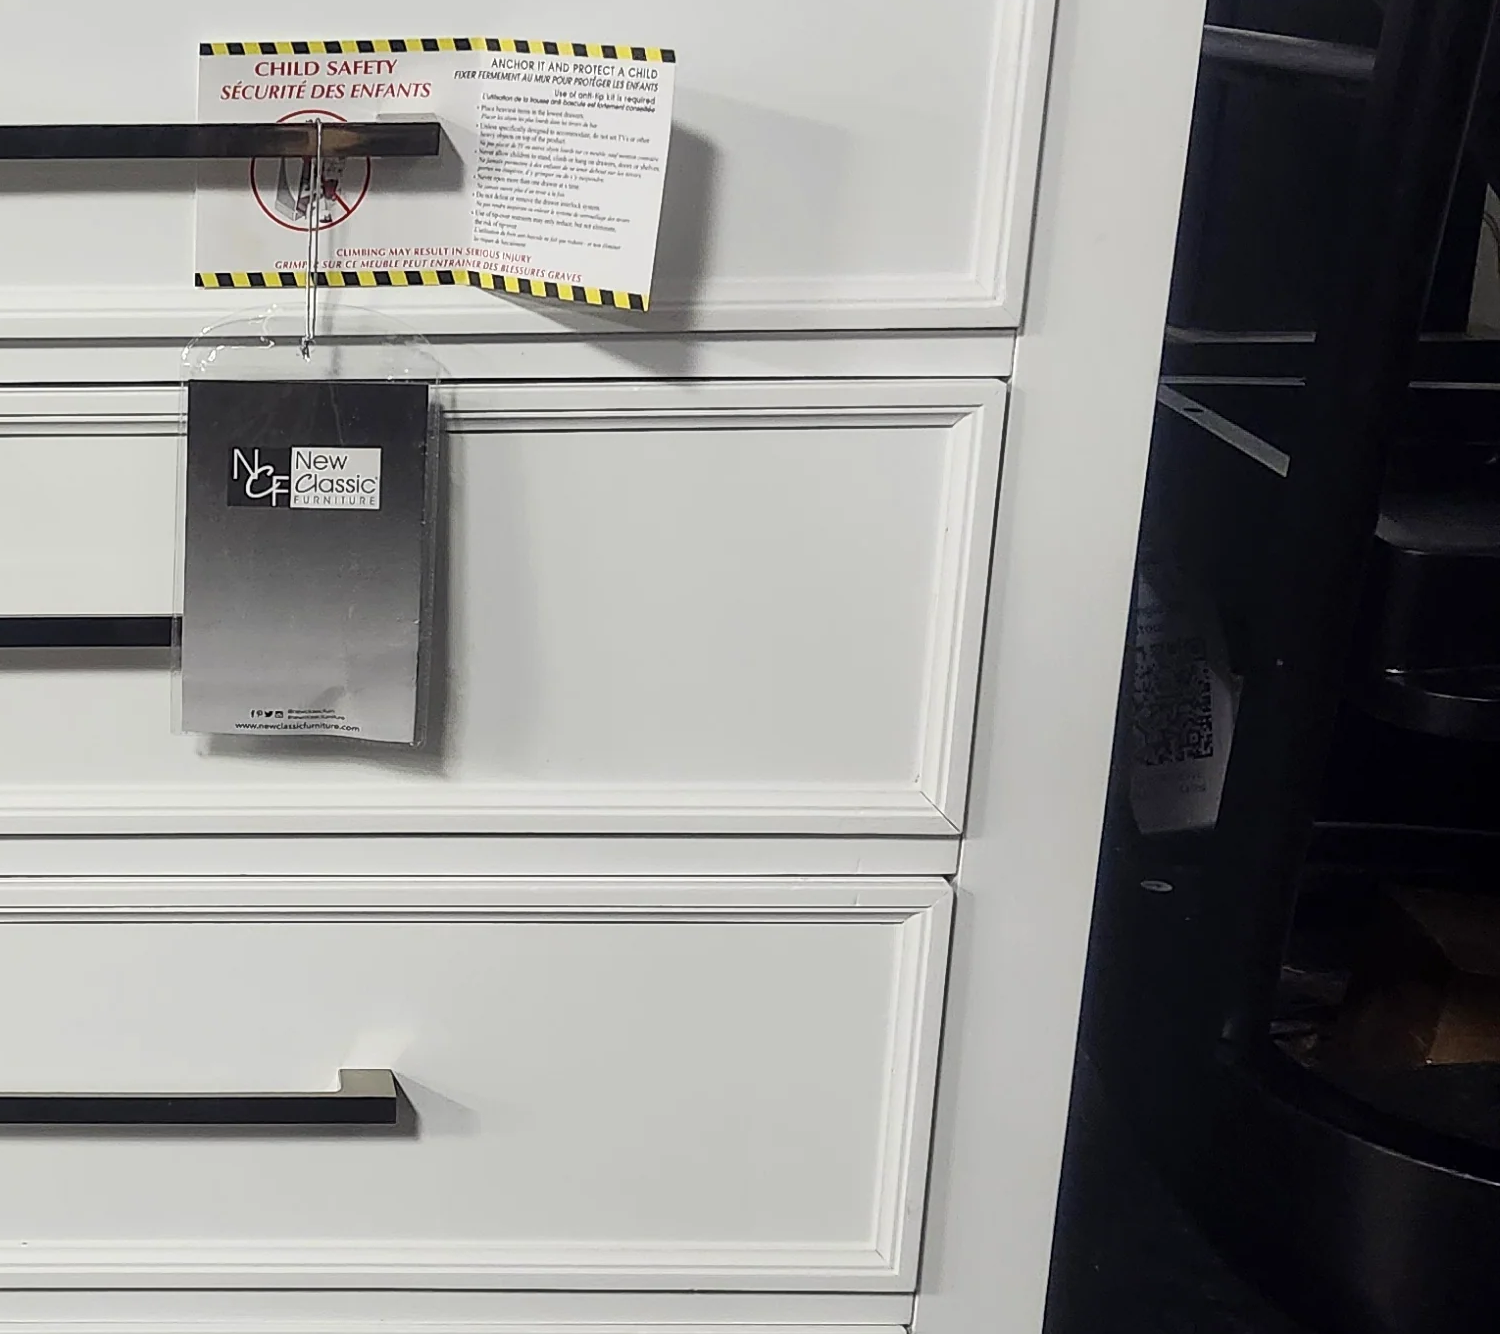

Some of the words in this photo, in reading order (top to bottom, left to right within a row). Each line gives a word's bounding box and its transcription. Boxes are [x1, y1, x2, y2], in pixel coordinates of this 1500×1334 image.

[254, 60, 321, 77] CHILD
[326, 59, 398, 76] SAFETY
[491, 58, 535, 71] ANCHOR
[537, 60, 546, 72] IT
[547, 61, 570, 73] AND
[573, 63, 615, 76] PROTECT
[617, 67, 625, 78] A
[627, 67, 658, 80] CHILD
[219, 79, 308, 101] SÉCURITÉ
[310, 83, 346, 100] DES
[350, 82, 432, 99] ENFANTS
[453, 70, 477, 80] FIXER
[477, 70, 521, 82] FERMEMENT
[521, 73, 534, 83] AU
[533, 74, 551, 84] MUR
[551, 75, 573, 86] POUR
[573, 76, 612, 88] PROTÉGER
[612, 79, 625, 90] LES
[626, 81, 659, 92] ENFANTS
[554, 89, 568, 98] Use
[623, 95, 656, 105] required
[336, 247, 386, 257] CLIMBING
[388, 247, 412, 256] MAY
[413, 247, 450, 256] RESULT
[451, 247, 463, 257] IN
[465, 247, 500, 260] SERIOUS
[502, 251, 532, 264] INJURY
[322, 260, 342, 269] SUR
[345, 260, 358, 269] CE
[360, 259, 400, 269] MEUBLE
[402, 259, 427, 268] PEUT
[429, 259, 482, 269] ENTRAINER
[483, 261, 499, 271] DES
[500, 263, 546, 278] BLESSURES
[547, 270, 583, 283] GRAVES
[295, 450, 348, 471] New
[232, 448, 290, 507] NCF
[294, 473, 377, 494] Classic
[293, 495, 376, 506] FURNITURE
[234, 721, 360, 733] www.newclassicfurniture.com
